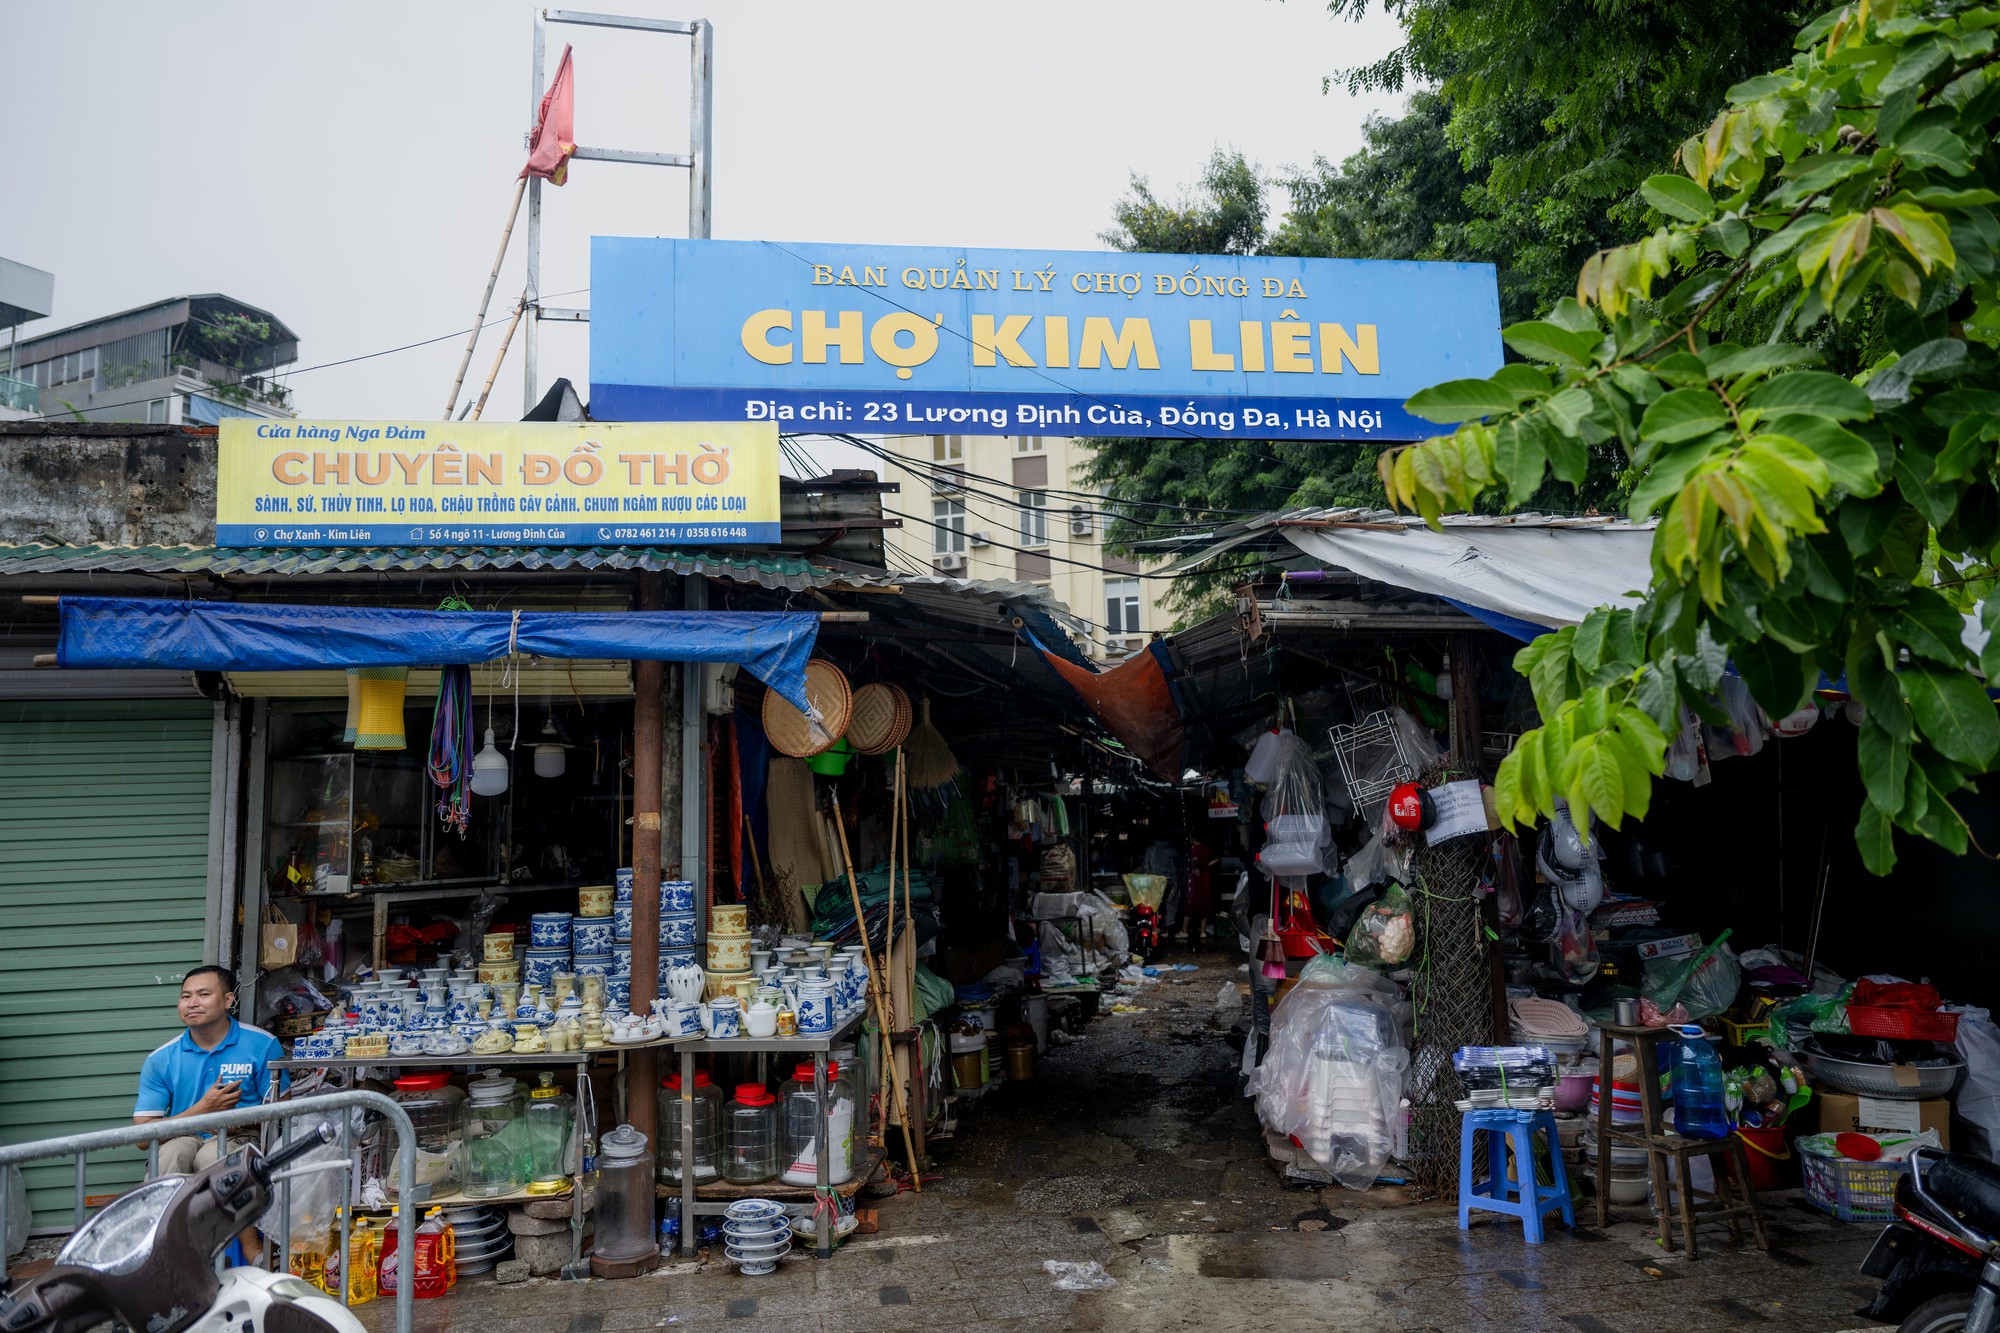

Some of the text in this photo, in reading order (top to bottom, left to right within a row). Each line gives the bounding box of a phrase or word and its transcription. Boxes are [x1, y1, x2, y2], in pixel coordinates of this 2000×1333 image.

[811, 258, 1308, 299] BAN QUẢN LÝ CHỢ ĐỐNG ĐA
[741, 308, 1380, 380] CHỢ KIM LIÊN
[745, 400, 1382, 433] Địa chỉ: 23 Lương Định Của, Đống Đa, Hà Nội
[257, 424, 426, 442] Cửa hàng Nga Đảm
[272, 441, 731, 486] CHUYÊN ĐỒ THỜ
[255, 491, 746, 515] SÀNH, SỨ, THỦY TINH, LỌ HOA, CHẬU TRỒNG CÂY CẢNH, CHUM NGÂM RƯỢU CÁC LOẠI
[273, 529, 294, 541] Chợ
[295, 528, 321, 540] Xanh
[328, 528, 348, 540] Kim
[350, 528, 371, 540] Liên
[429, 527, 442, 540] Số
[443, 529, 450, 540] 4
[451, 528, 470, 543] ngõ
[472, 529, 483, 540] 11
[491, 528, 521, 541] Lương
[523, 528, 546, 542] Định
[547, 528, 565, 540] Của
[615, 528, 638, 539] 0782
[639, 528, 657, 538] 461
[658, 528, 676, 538] 214
[686, 528, 710, 538] 0358
[711, 528, 728, 538] 616
[729, 527, 747, 538] 448
[220, 1063, 253, 1076] PUMA
